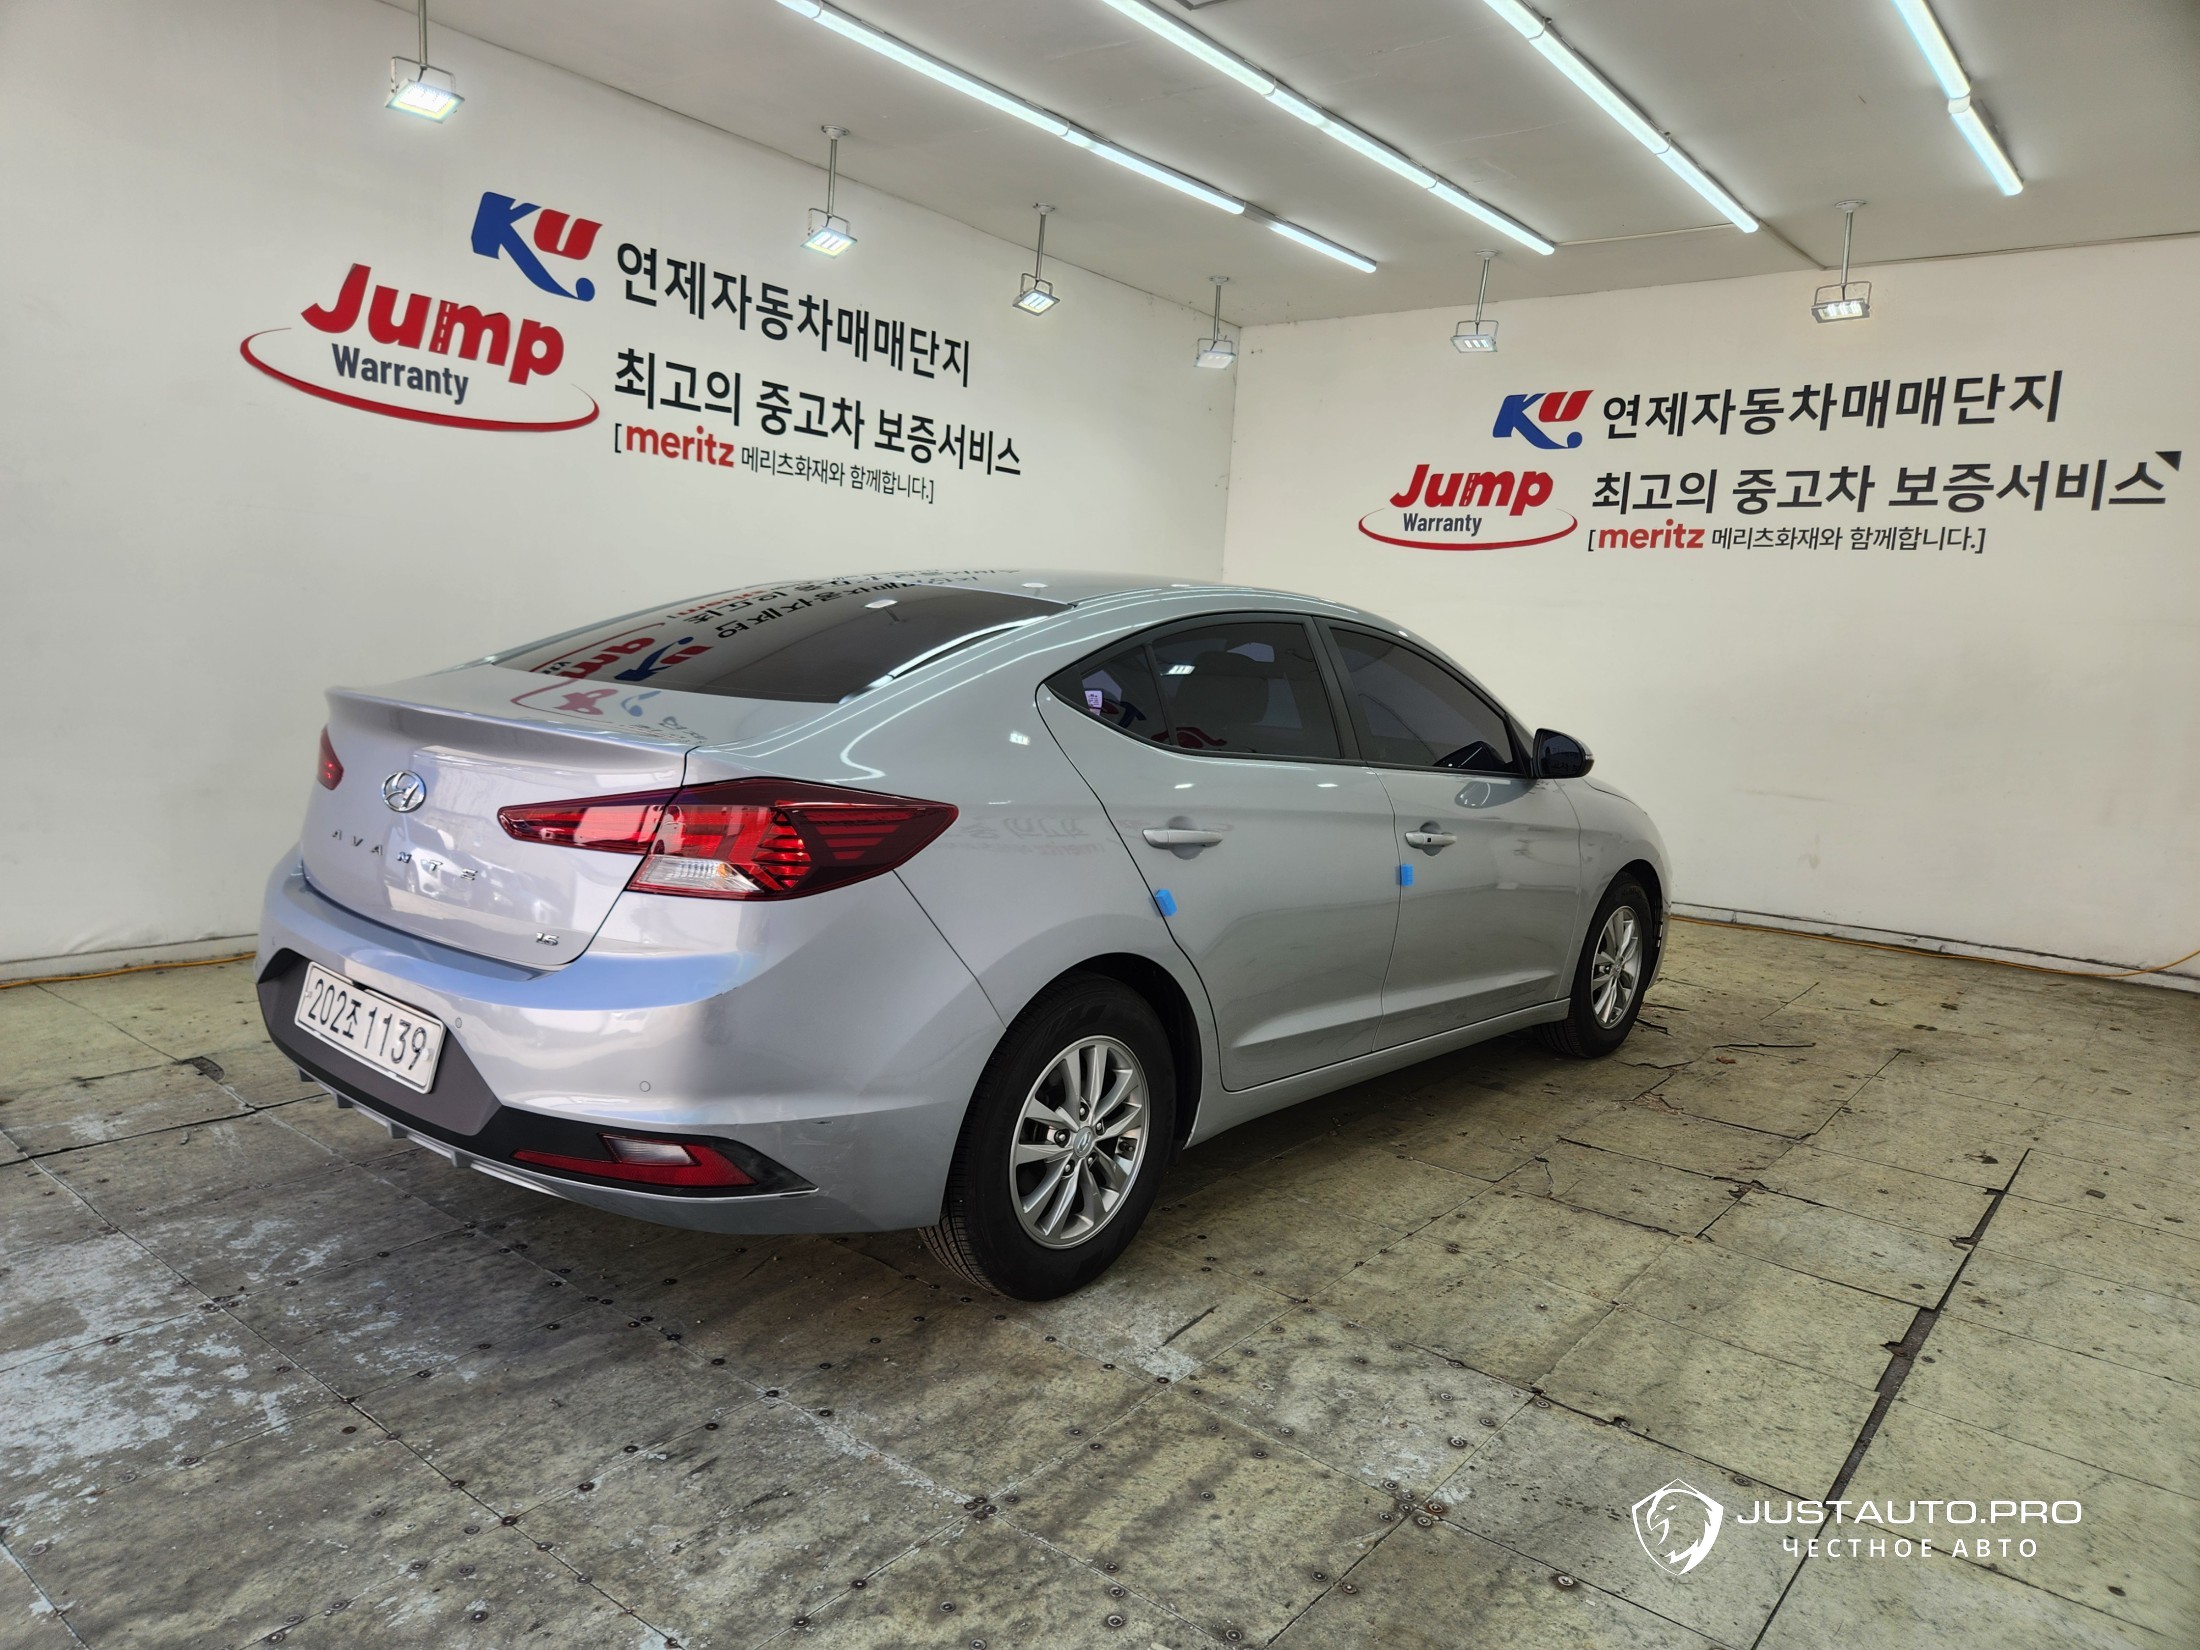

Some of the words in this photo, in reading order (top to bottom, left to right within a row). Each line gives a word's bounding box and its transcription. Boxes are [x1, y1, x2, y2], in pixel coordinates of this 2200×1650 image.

[300, 262, 565, 386] Jump
[617, 242, 970, 388] 연제자동차매매단지
[331, 343, 470, 405] Warranty
[614, 348, 742, 426] 최고의
[756, 380, 865, 450] 중고차
[874, 409, 1022, 476] 보증서비스
[1602, 370, 2063, 439] 연제자동차매매단지
[741, 446, 845, 487] 메리츠화재와
[1389, 464, 1554, 516] Jump
[1592, 468, 1718, 515] 최고의
[1731, 465, 1876, 515] 중고차
[1888, 459, 2167, 513] 보증서비스
[1403, 512, 1482, 537] Warranty
[1711, 526, 1843, 551] 메리츠화재와
[332, 829, 479, 882] AVANTE
